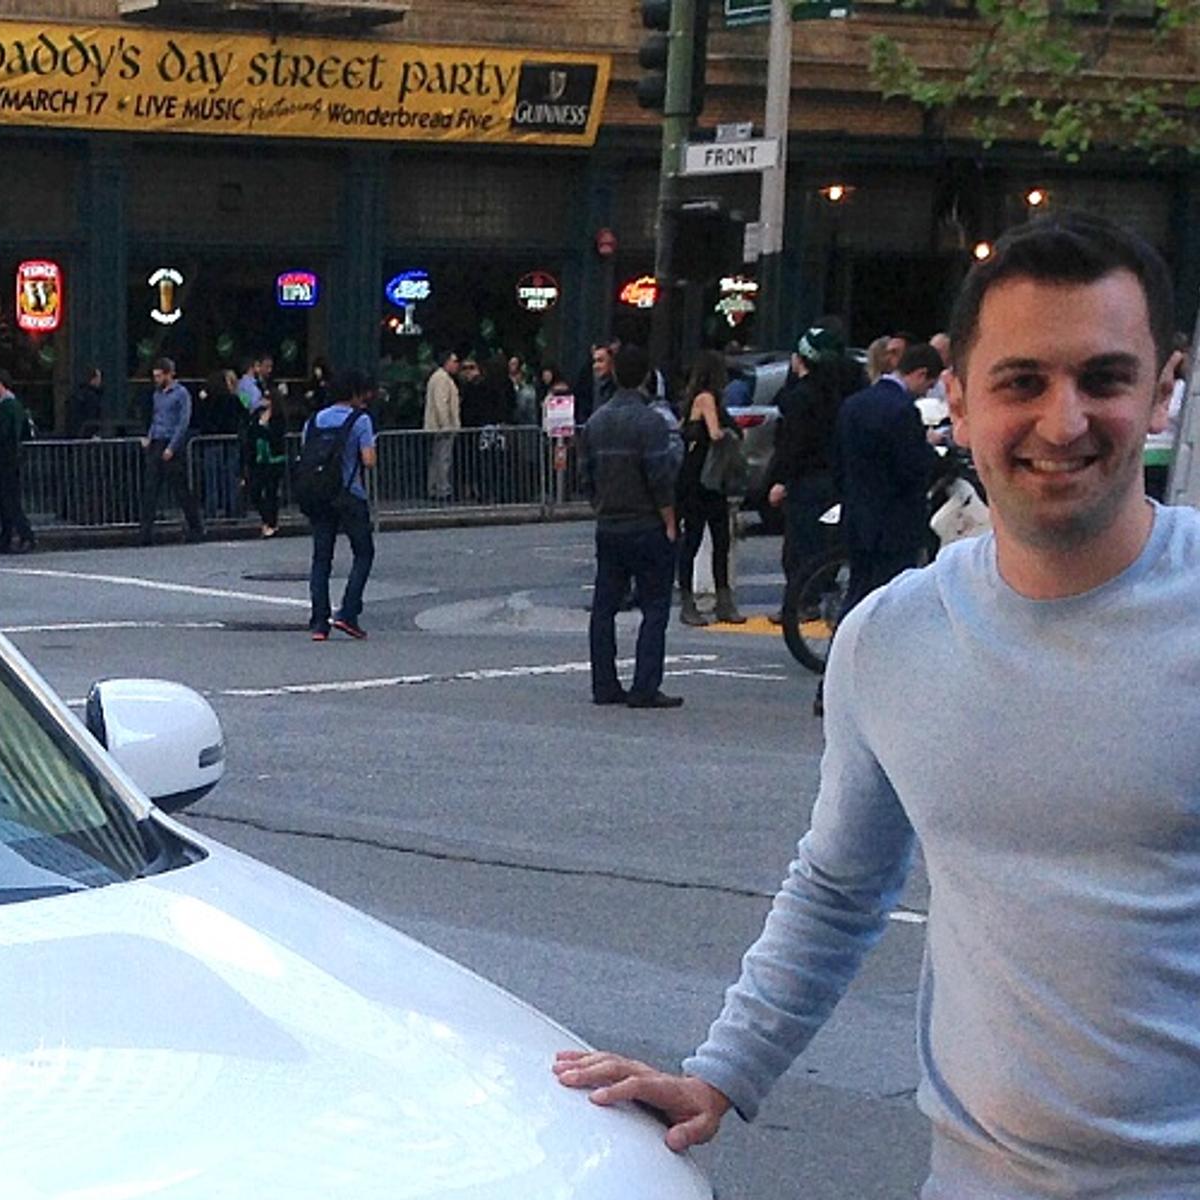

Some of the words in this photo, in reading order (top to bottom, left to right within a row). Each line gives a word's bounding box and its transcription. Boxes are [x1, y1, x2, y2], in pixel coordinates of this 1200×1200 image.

[157, 40, 234, 93] day
[397, 57, 517, 105] party
[85, 92, 108, 115] 17
[133, 94, 178, 118] LIVE
[182, 97, 245, 121] MUSIC
[514, 99, 588, 126] GUINNESS
[704, 146, 757, 166] FRONT
